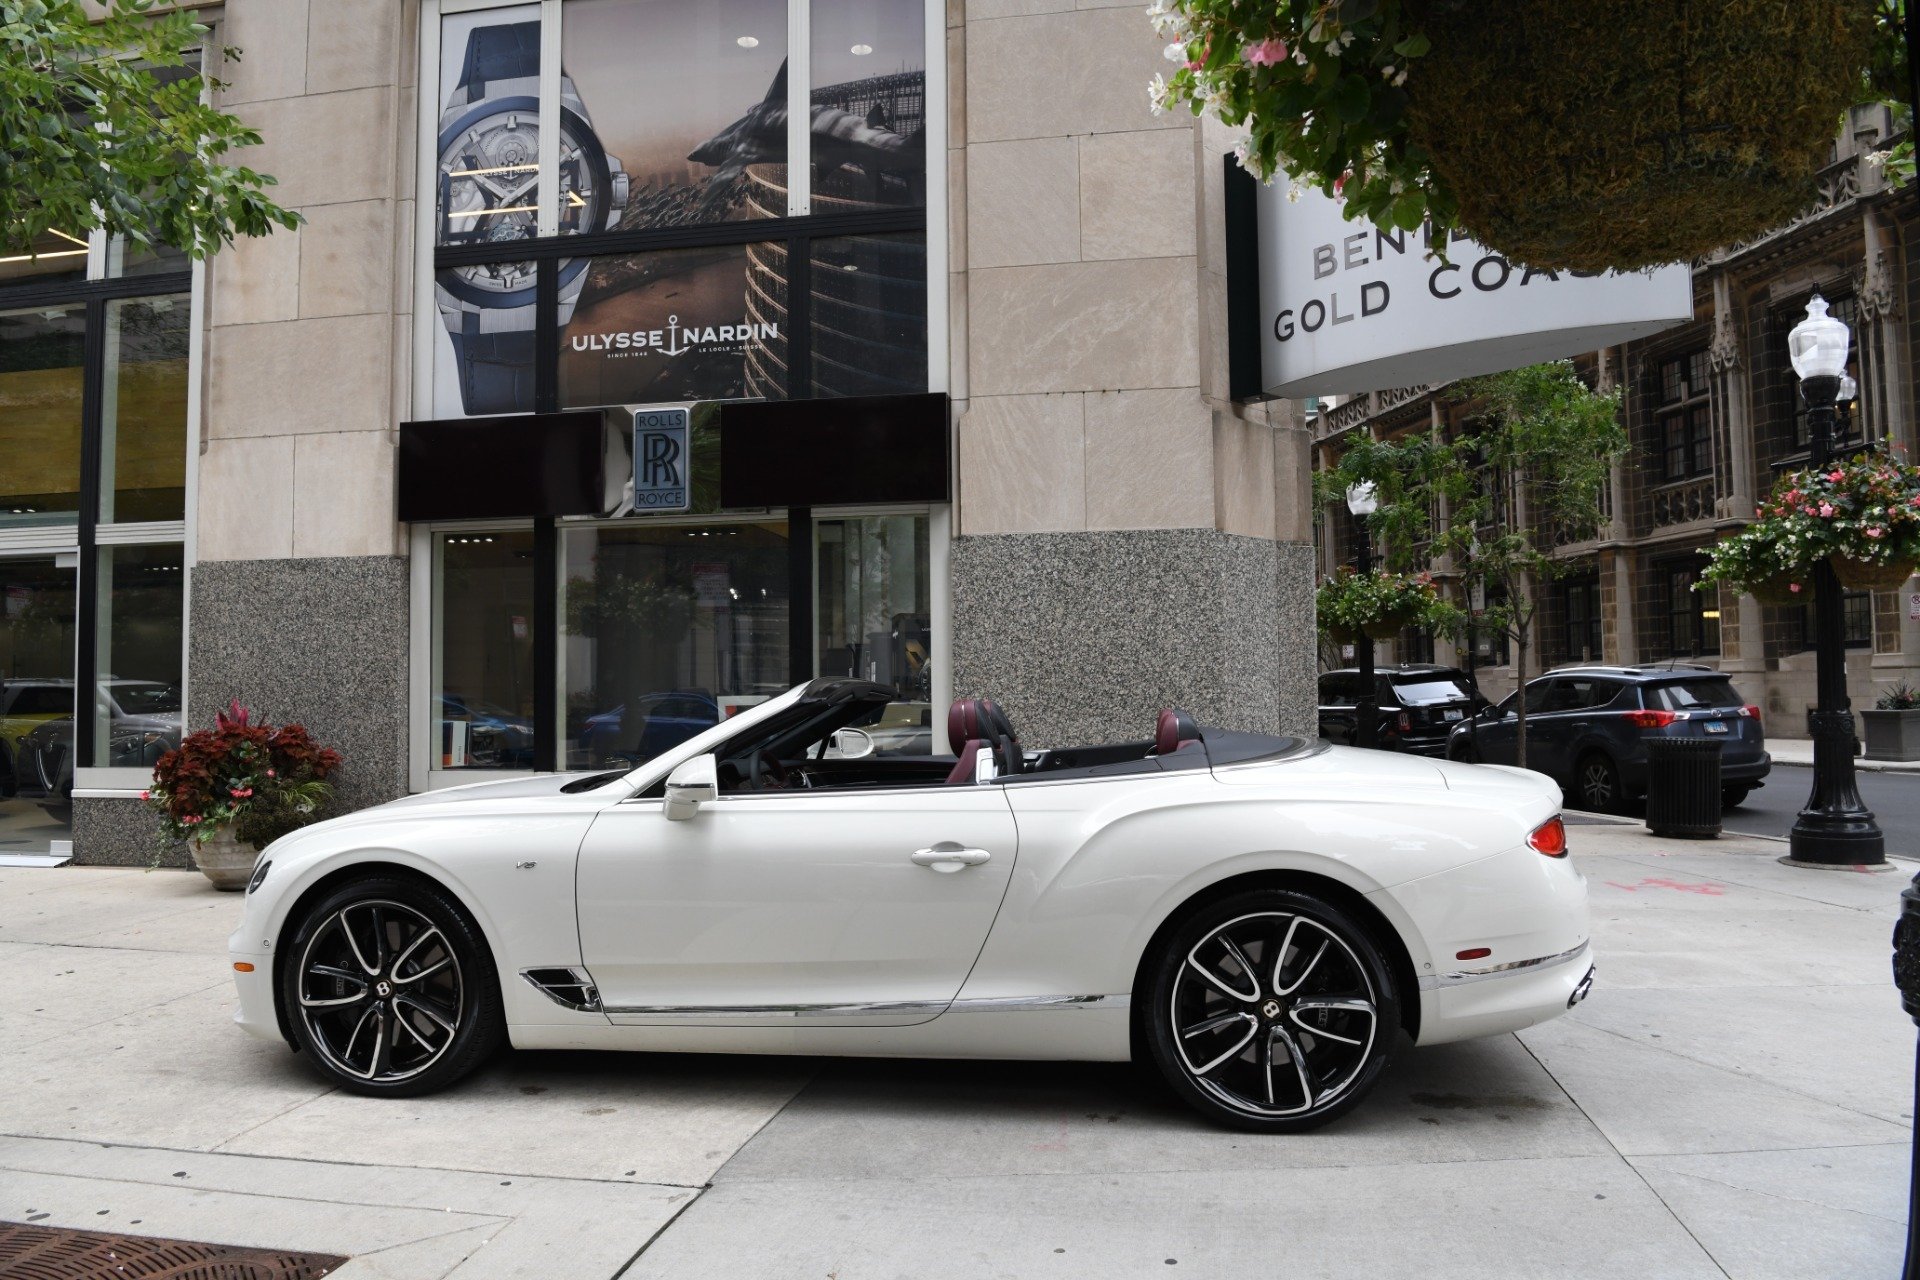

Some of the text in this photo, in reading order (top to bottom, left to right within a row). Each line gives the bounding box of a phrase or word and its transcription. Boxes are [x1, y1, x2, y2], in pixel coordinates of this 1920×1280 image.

[1274, 280, 1390, 341] GOLD
[572, 322, 778, 351] ULYSSE NARDIN
[639, 413, 682, 427] ROLLS
[638, 491, 682, 505] ROYCE
